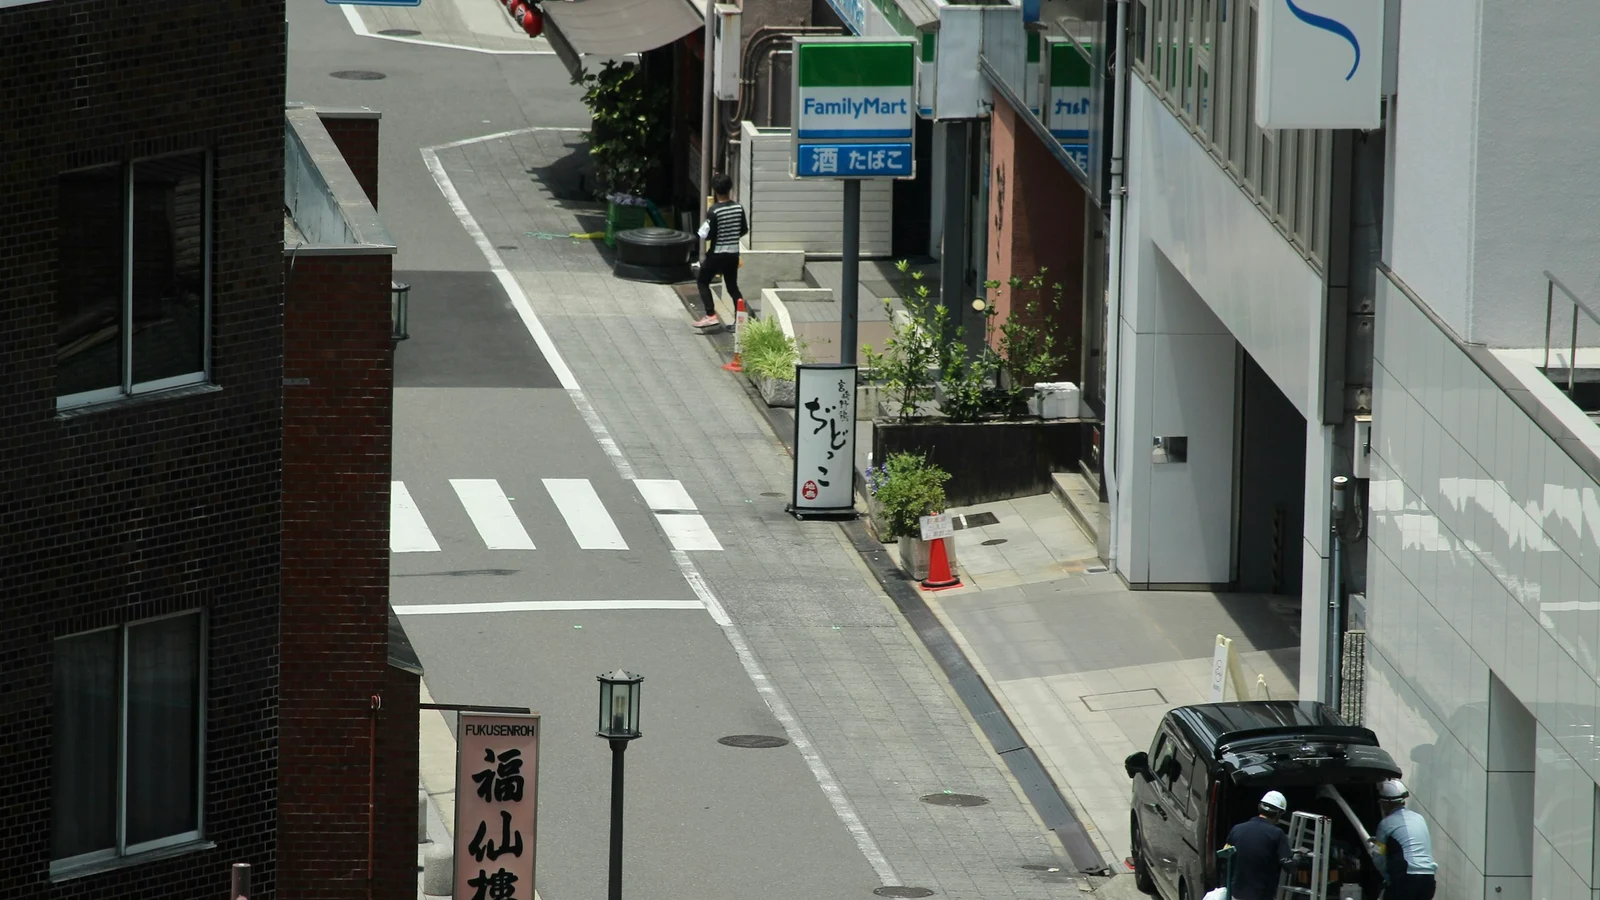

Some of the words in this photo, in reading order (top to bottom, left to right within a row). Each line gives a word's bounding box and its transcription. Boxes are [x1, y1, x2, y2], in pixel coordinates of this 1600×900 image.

[804, 97, 907, 119] FamilyMart
[811, 147, 839, 173] 酒
[849, 149, 903, 170] たばこ
[804, 397, 849, 487] ぢどっこ
[465, 724, 535, 737] FUKUSENROH
